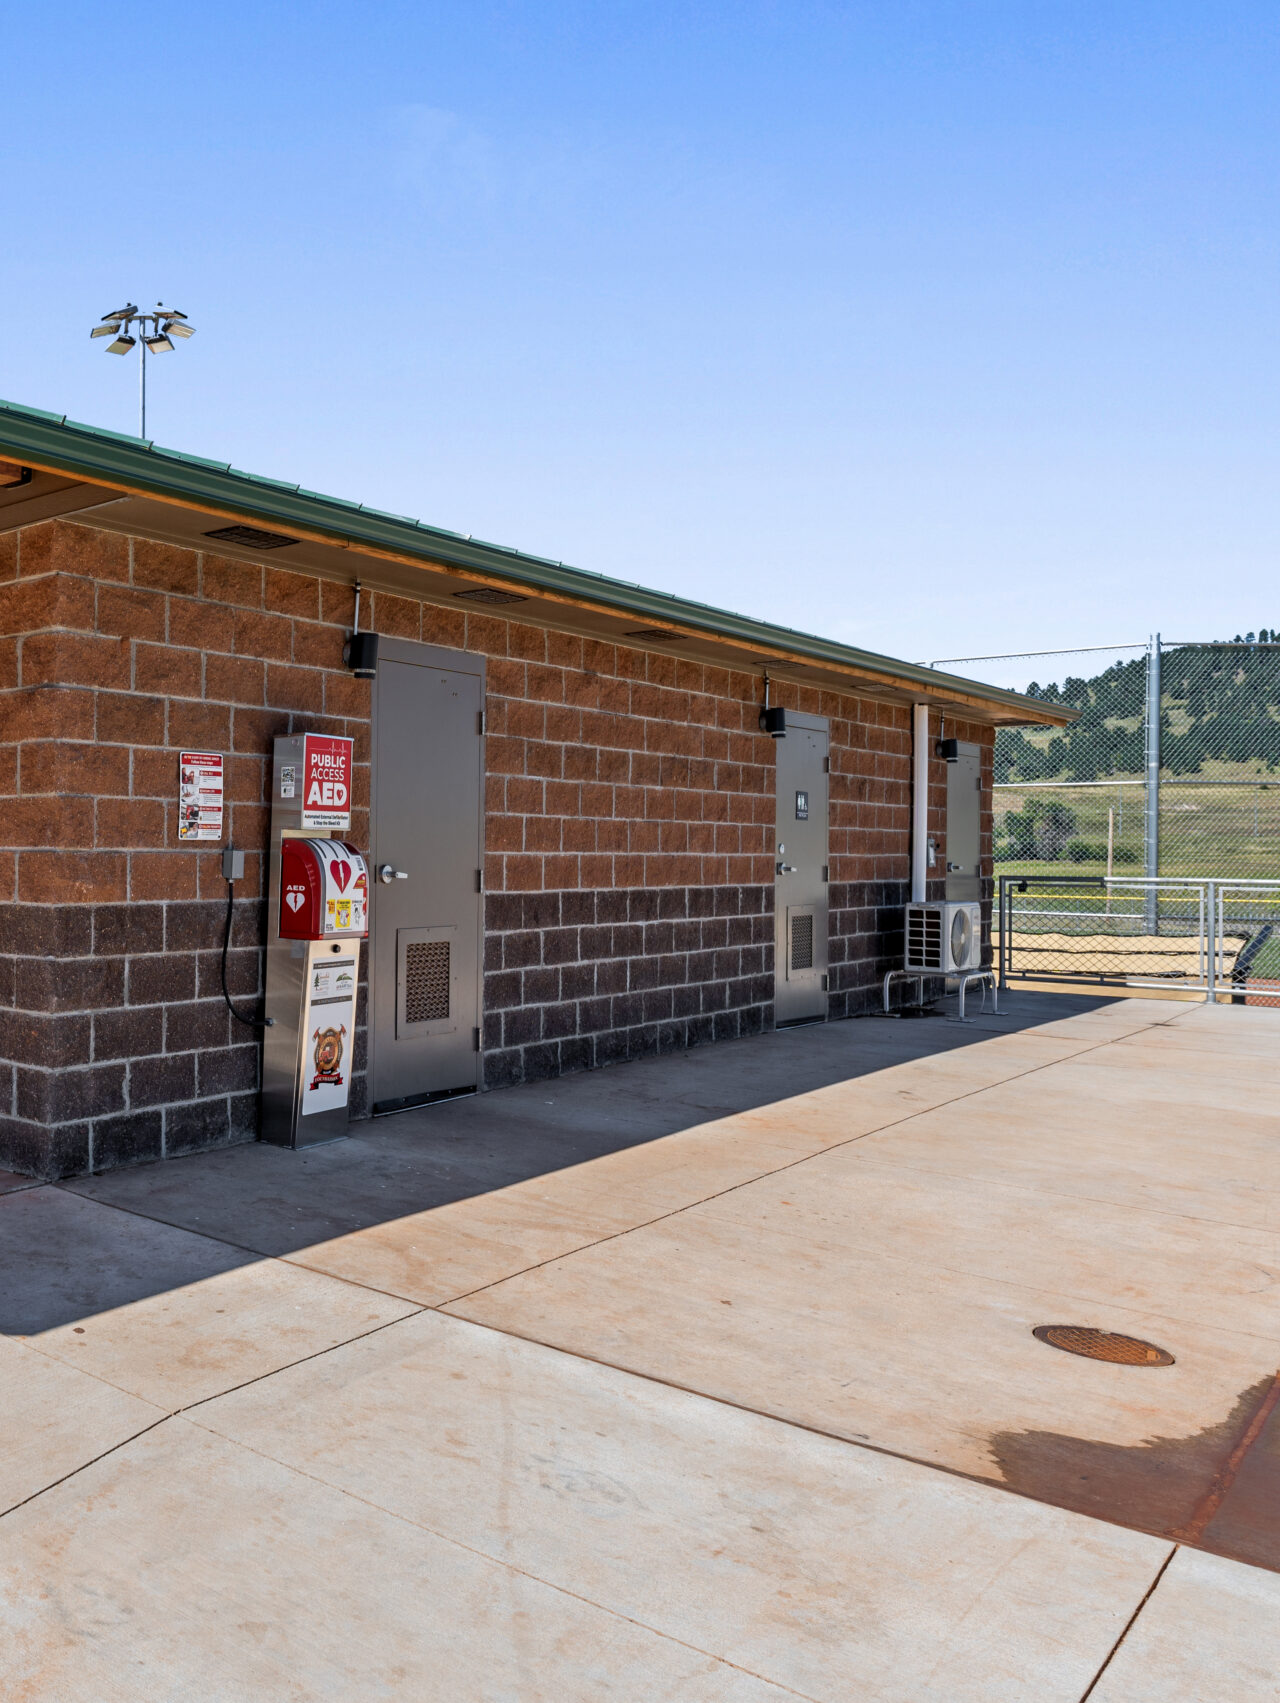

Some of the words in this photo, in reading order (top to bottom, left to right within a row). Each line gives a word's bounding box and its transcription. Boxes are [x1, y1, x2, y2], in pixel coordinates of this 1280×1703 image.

[311, 753, 346, 768] PUBLIC
[311, 768, 345, 781] ACCESS
[307, 781, 347, 807] AED
[286, 884, 306, 892] AED
